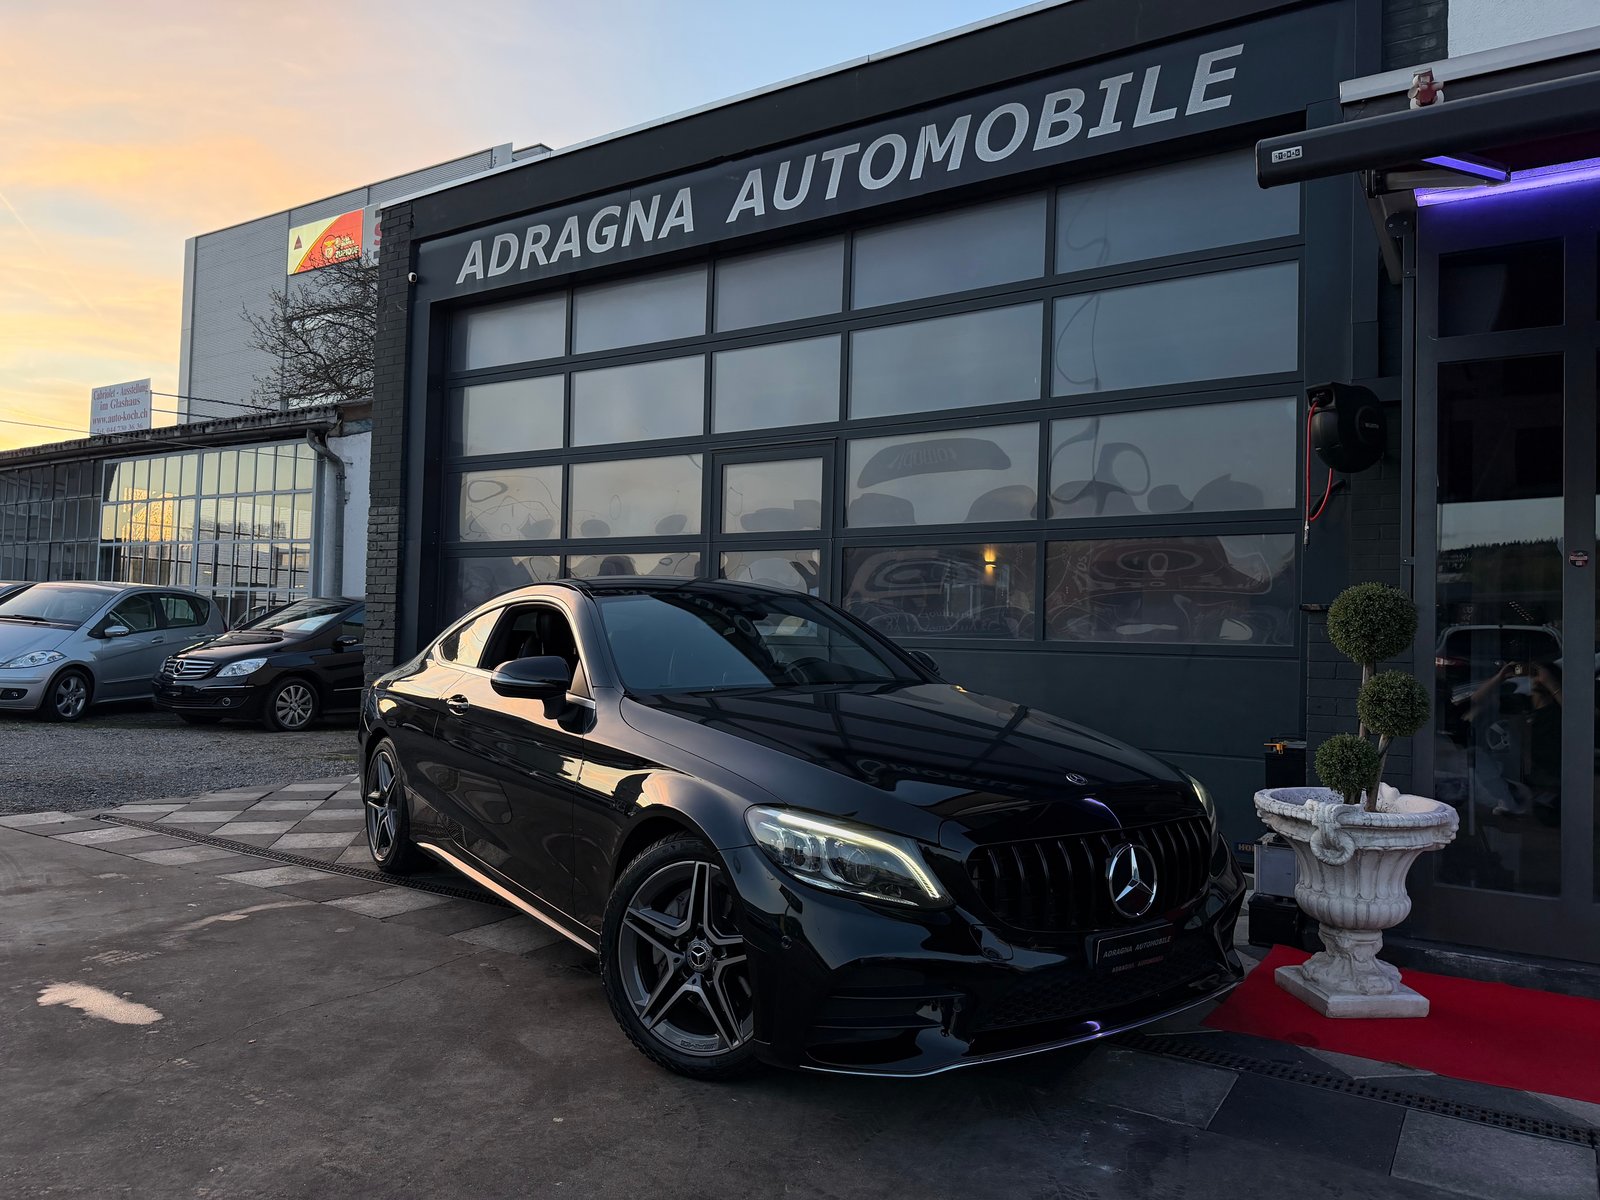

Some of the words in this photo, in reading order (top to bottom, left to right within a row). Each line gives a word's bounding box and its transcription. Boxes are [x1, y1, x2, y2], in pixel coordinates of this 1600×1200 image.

[456, 187, 694, 285] ADRAGNA
[725, 43, 1244, 224] AUTOMOBILE
[110, 396, 141, 410] Glashaus
[92, 408, 148, 425] www.auto-koch.ch
